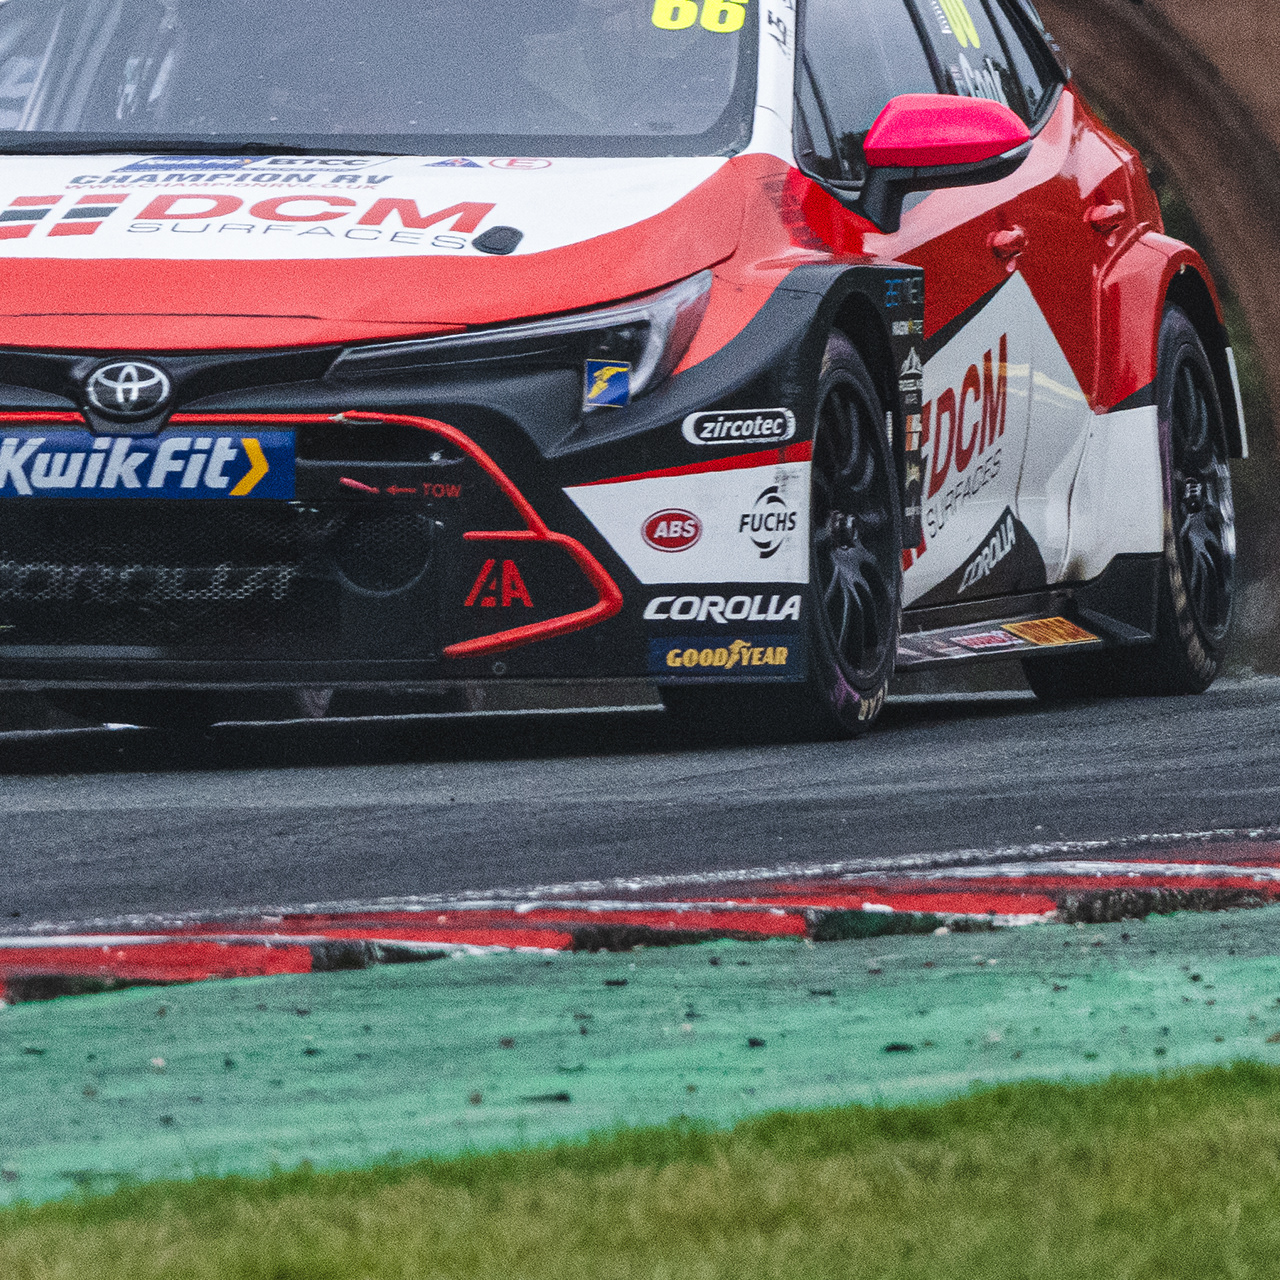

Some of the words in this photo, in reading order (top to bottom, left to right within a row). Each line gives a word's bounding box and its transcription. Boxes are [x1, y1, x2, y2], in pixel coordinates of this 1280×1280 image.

[267, 158, 371, 167] BTCC
[69, 173, 317, 185] CHAMPION
[331, 175, 393, 185] RV
[134, 193, 497, 234] DCM
[126, 221, 467, 251] SURFACES
[698, 415, 785, 439] zircotec
[927, 332, 1008, 501] DCM
[422, 482, 462, 499] TOW
[926, 448, 1003, 540] SURFACES
[654, 517, 697, 540] ABS
[739, 510, 798, 535] FUCHS
[957, 514, 1018, 595] COROLLA
[642, 594, 802, 624] COROLLA
[666, 638, 789, 670] GOODYEAR
